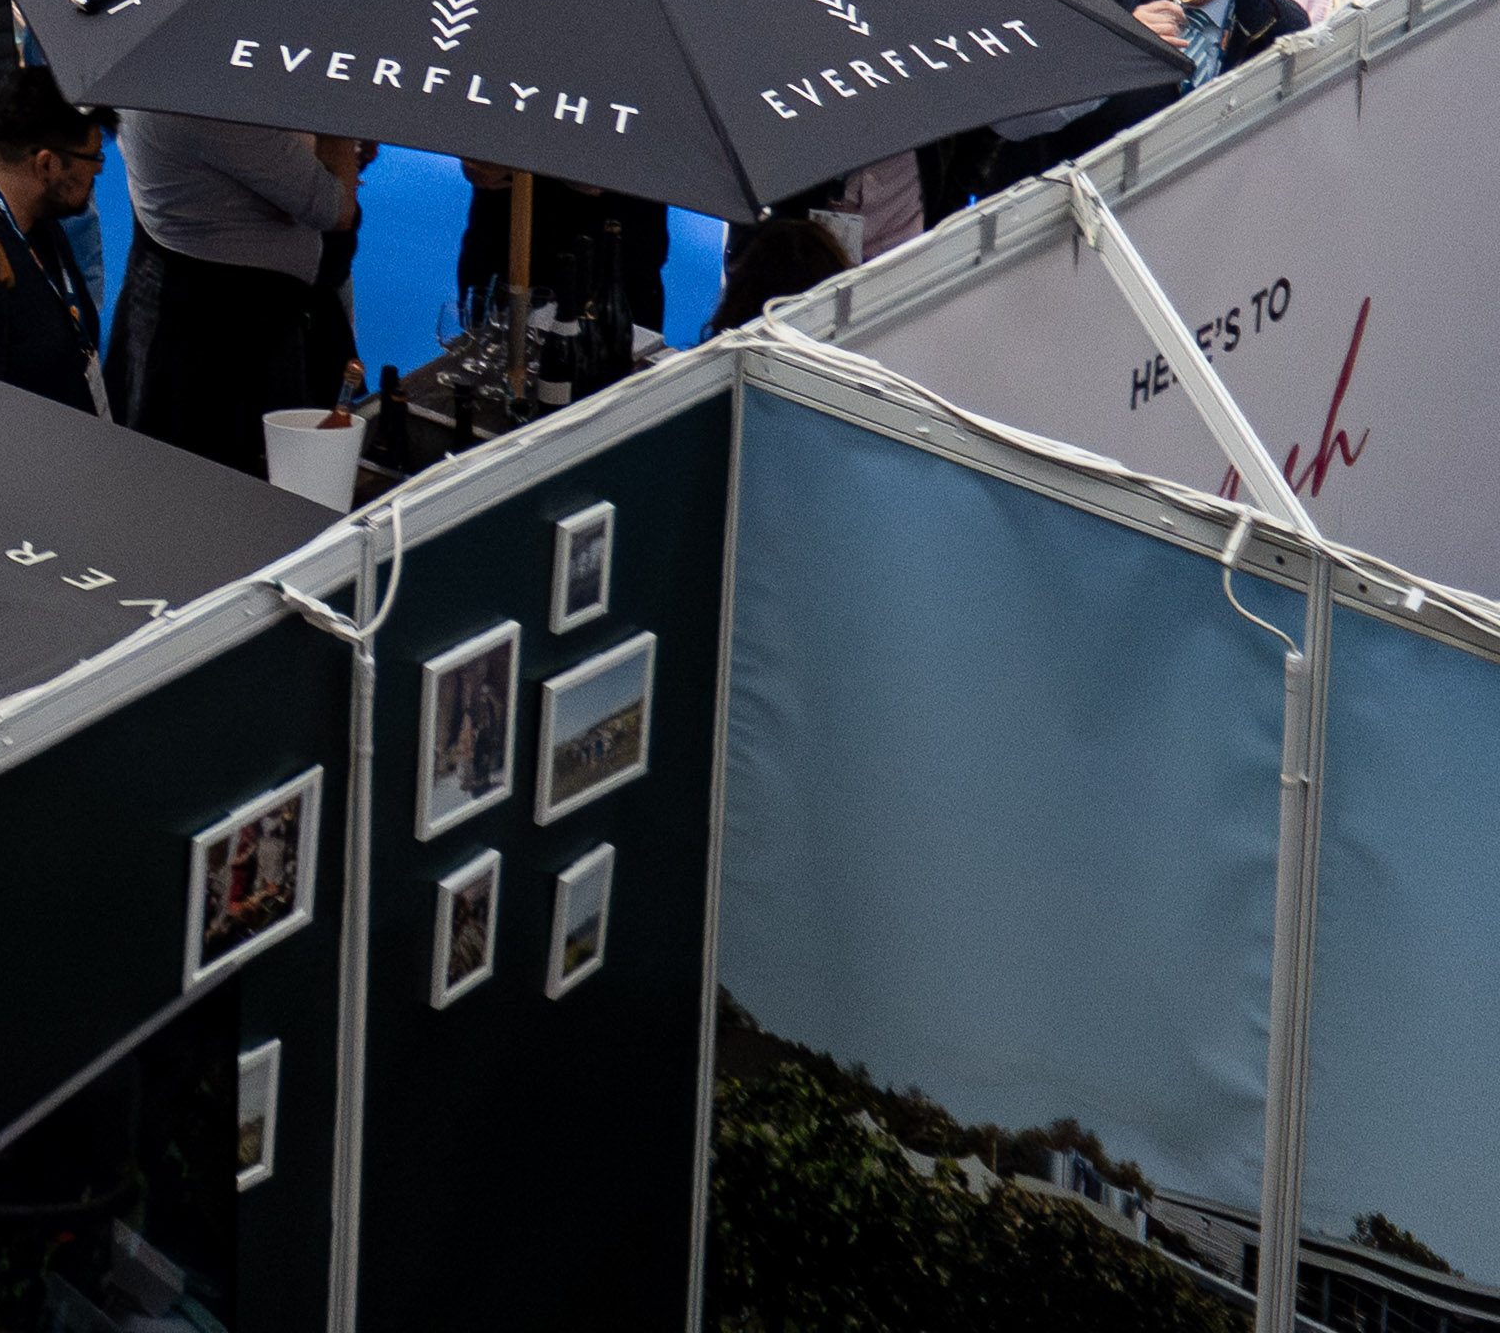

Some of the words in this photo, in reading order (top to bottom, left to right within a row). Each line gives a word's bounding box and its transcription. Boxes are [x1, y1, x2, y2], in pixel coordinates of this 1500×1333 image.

[229, 37, 641, 137] EVERFLYHT
[758, 15, 1042, 123] EVERFLYHT
[1130, 306, 1242, 411] HEE'S
[1251, 276, 1292, 334] TO
